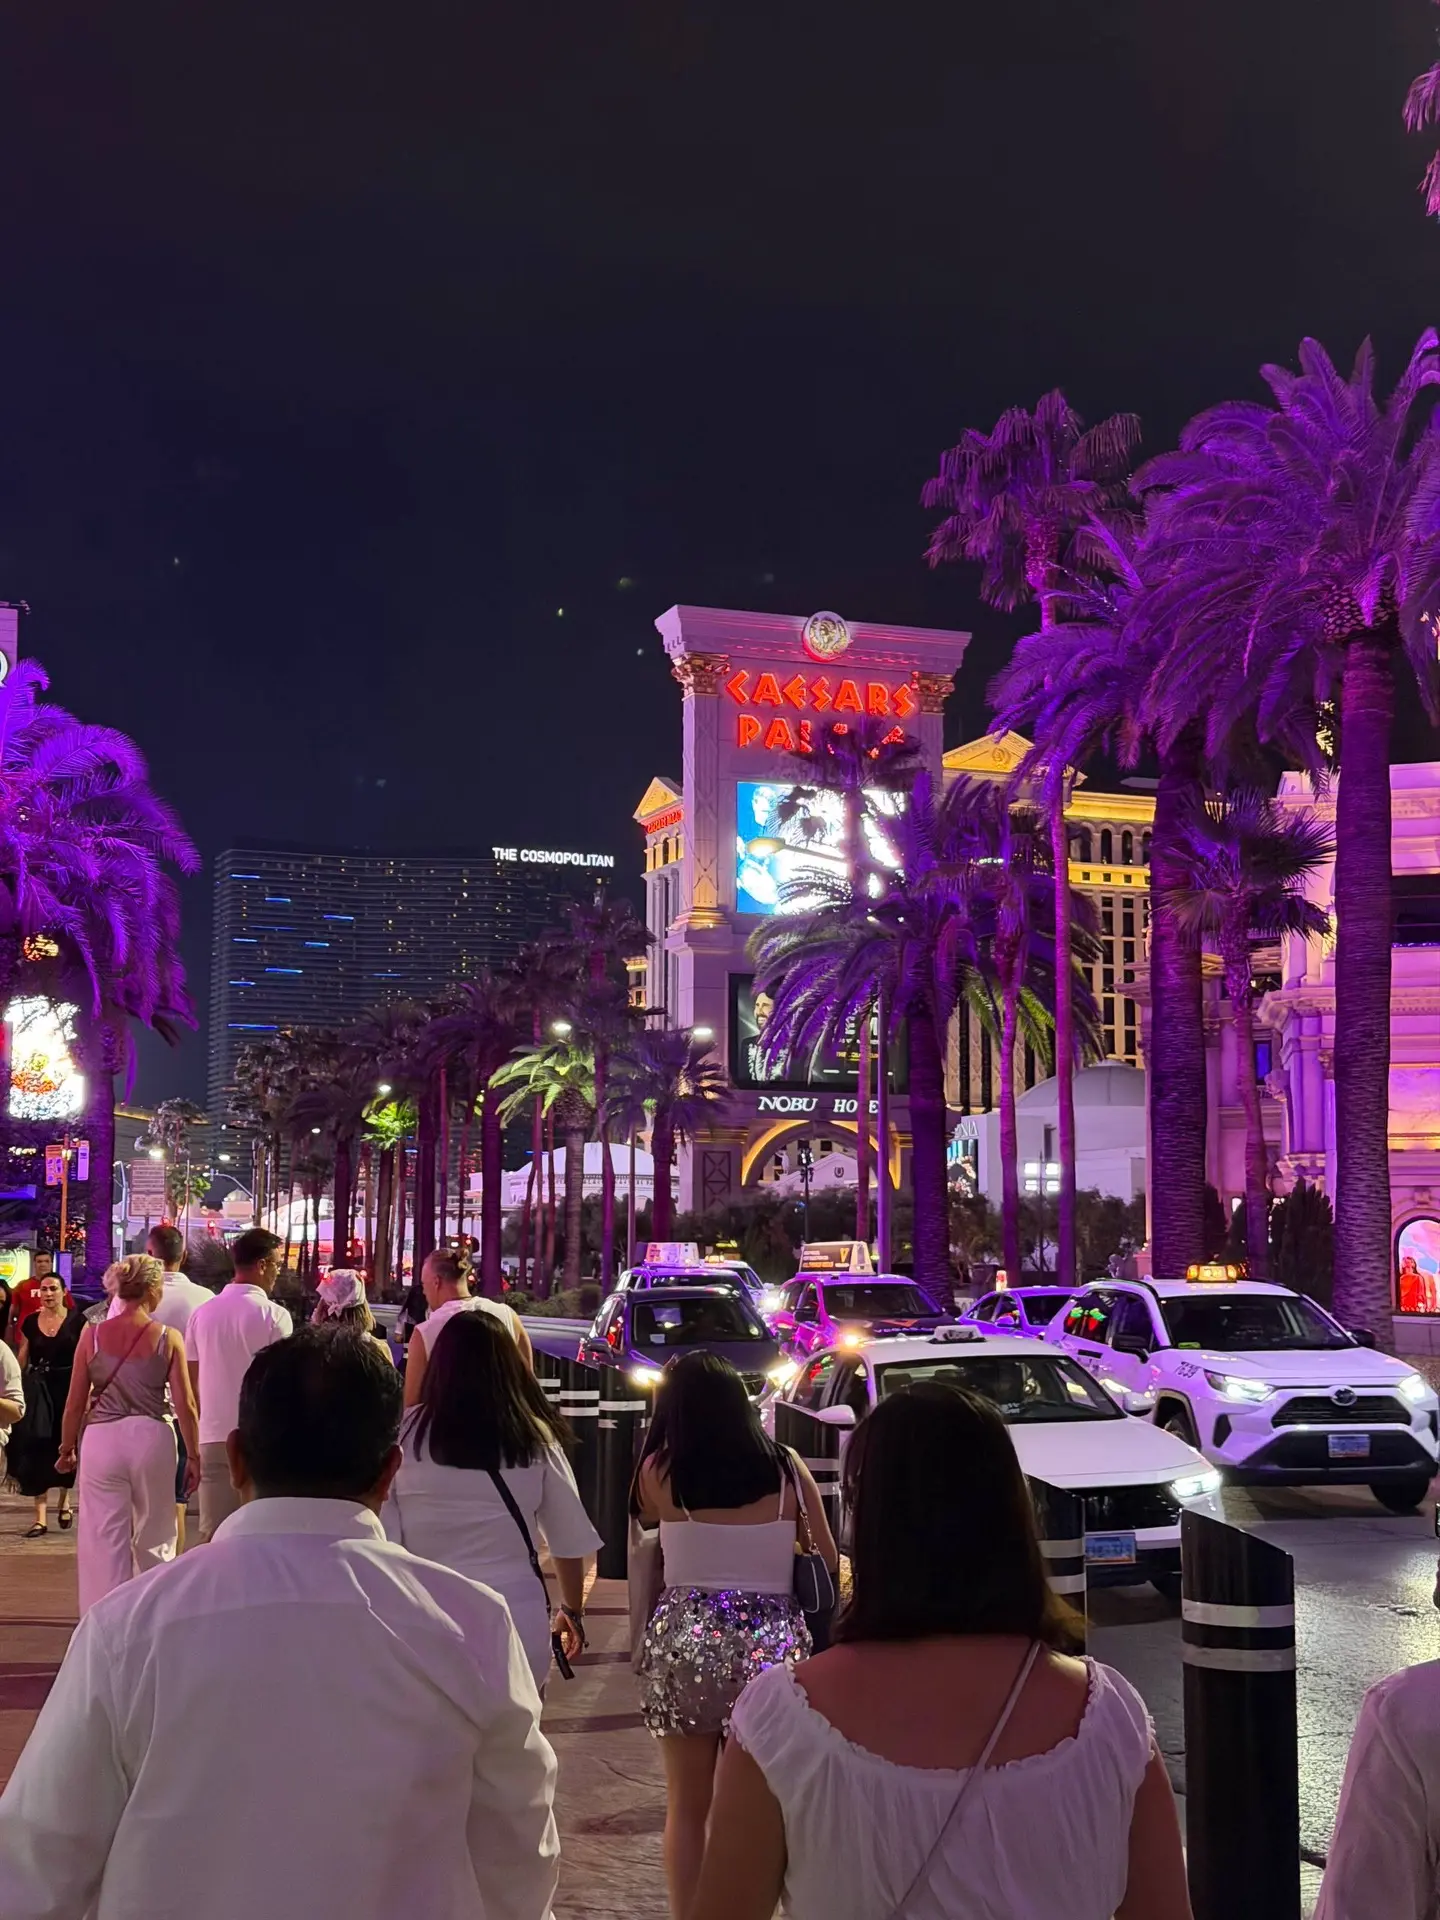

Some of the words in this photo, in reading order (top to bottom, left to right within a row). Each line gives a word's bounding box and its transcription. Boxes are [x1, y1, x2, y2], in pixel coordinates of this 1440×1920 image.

[727, 669, 916, 718] CAESARS
[738, 713, 905, 759] PAL
[492, 846, 518, 861] THE
[520, 848, 614, 868] COSMOPOLITAN
[758, 1096, 818, 1112] NOBU
